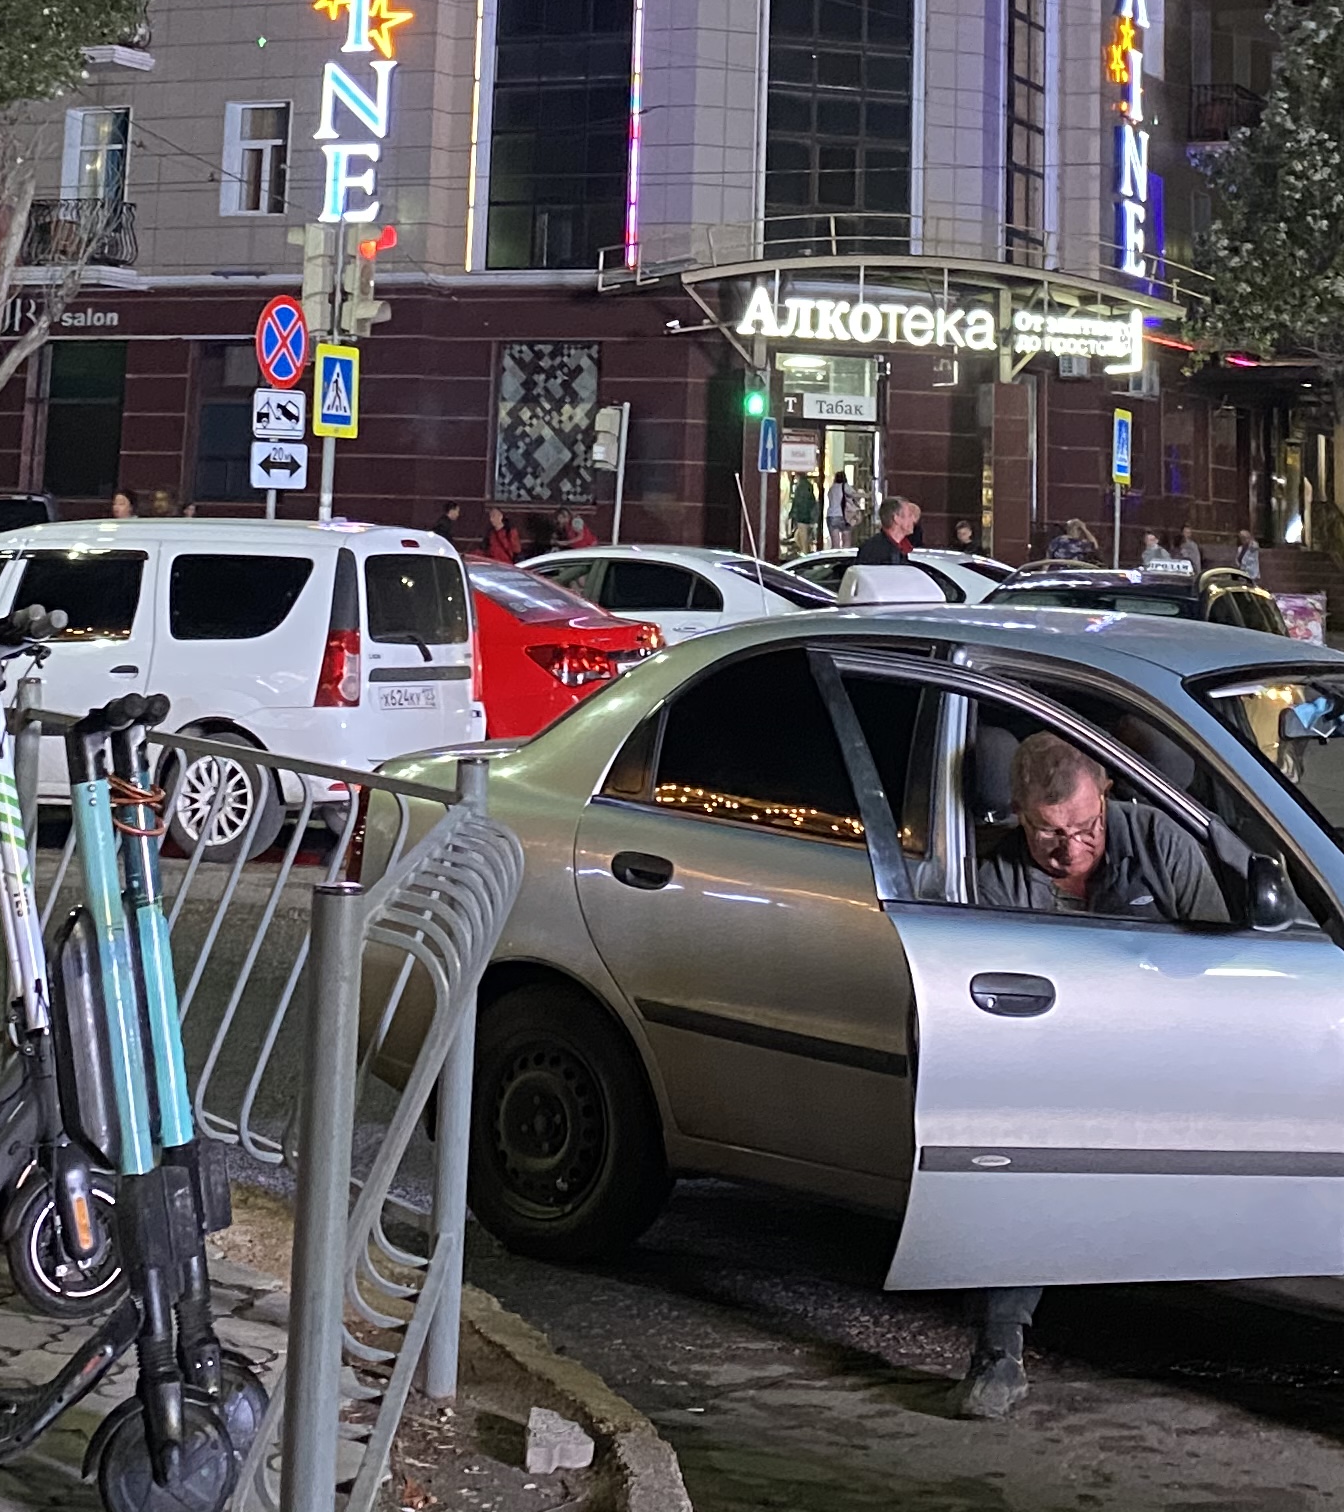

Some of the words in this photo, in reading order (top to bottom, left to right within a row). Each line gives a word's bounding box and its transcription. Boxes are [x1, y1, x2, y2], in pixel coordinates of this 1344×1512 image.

[61, 307, 119, 327] salon
[737, 286, 997, 351] Алкотека
[816, 399, 865, 417] Табак
